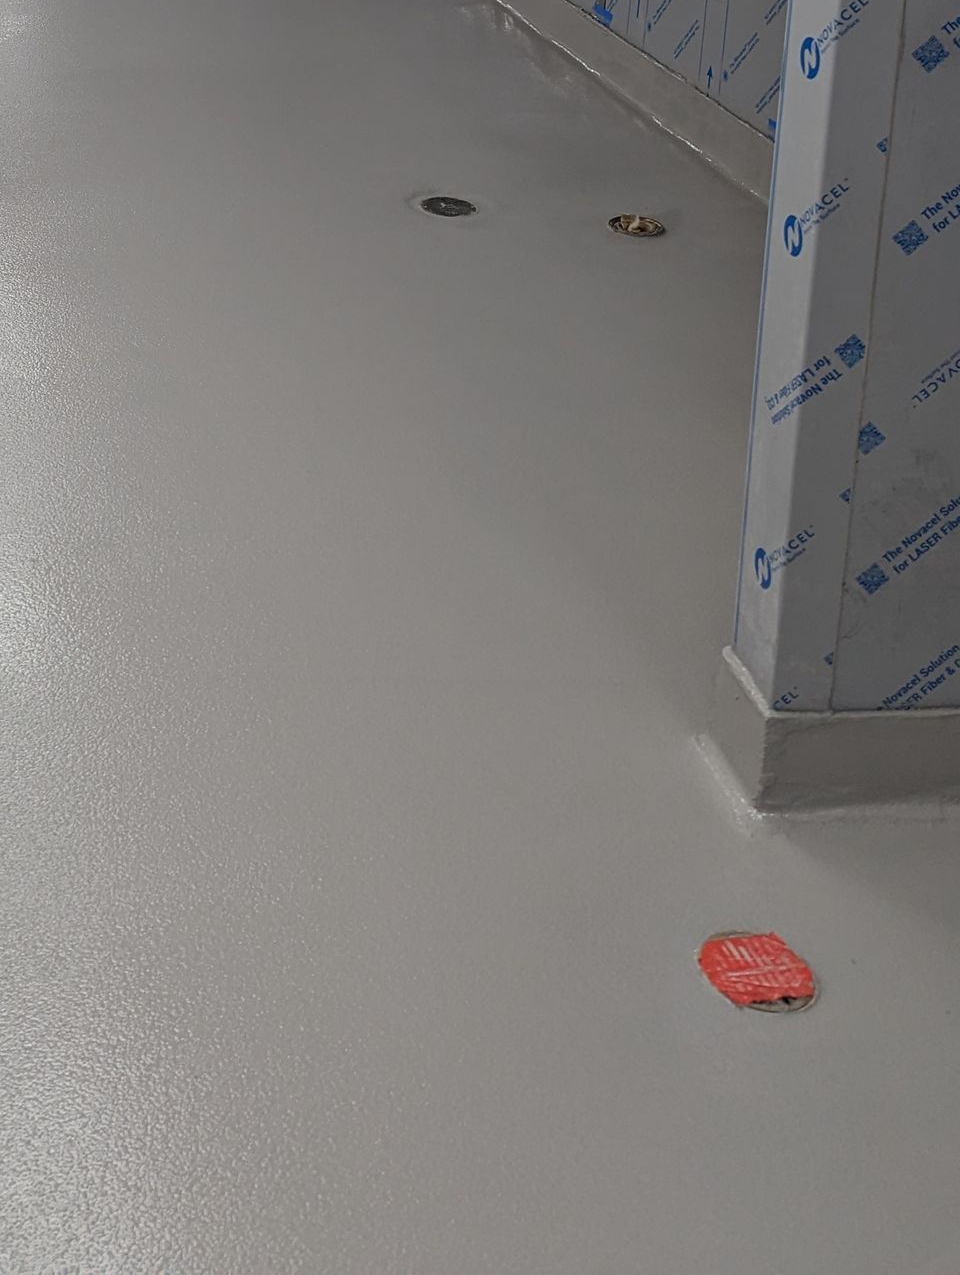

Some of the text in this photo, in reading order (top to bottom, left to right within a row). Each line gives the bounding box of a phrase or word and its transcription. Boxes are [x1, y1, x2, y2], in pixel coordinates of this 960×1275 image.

[800, 183, 850, 227] NOVACEL
[920, 202, 943, 220] The
[932, 216, 950, 233] for
[814, 355, 831, 370] for
[820, 369, 843, 385] The
[881, 546, 903, 562] The
[901, 512, 941, 548] Novacel
[892, 559, 909, 574] for
[907, 532, 943, 562] LASER
[882, 645, 960, 708] Novacel Solution
[920, 673, 946, 695] Fiber
